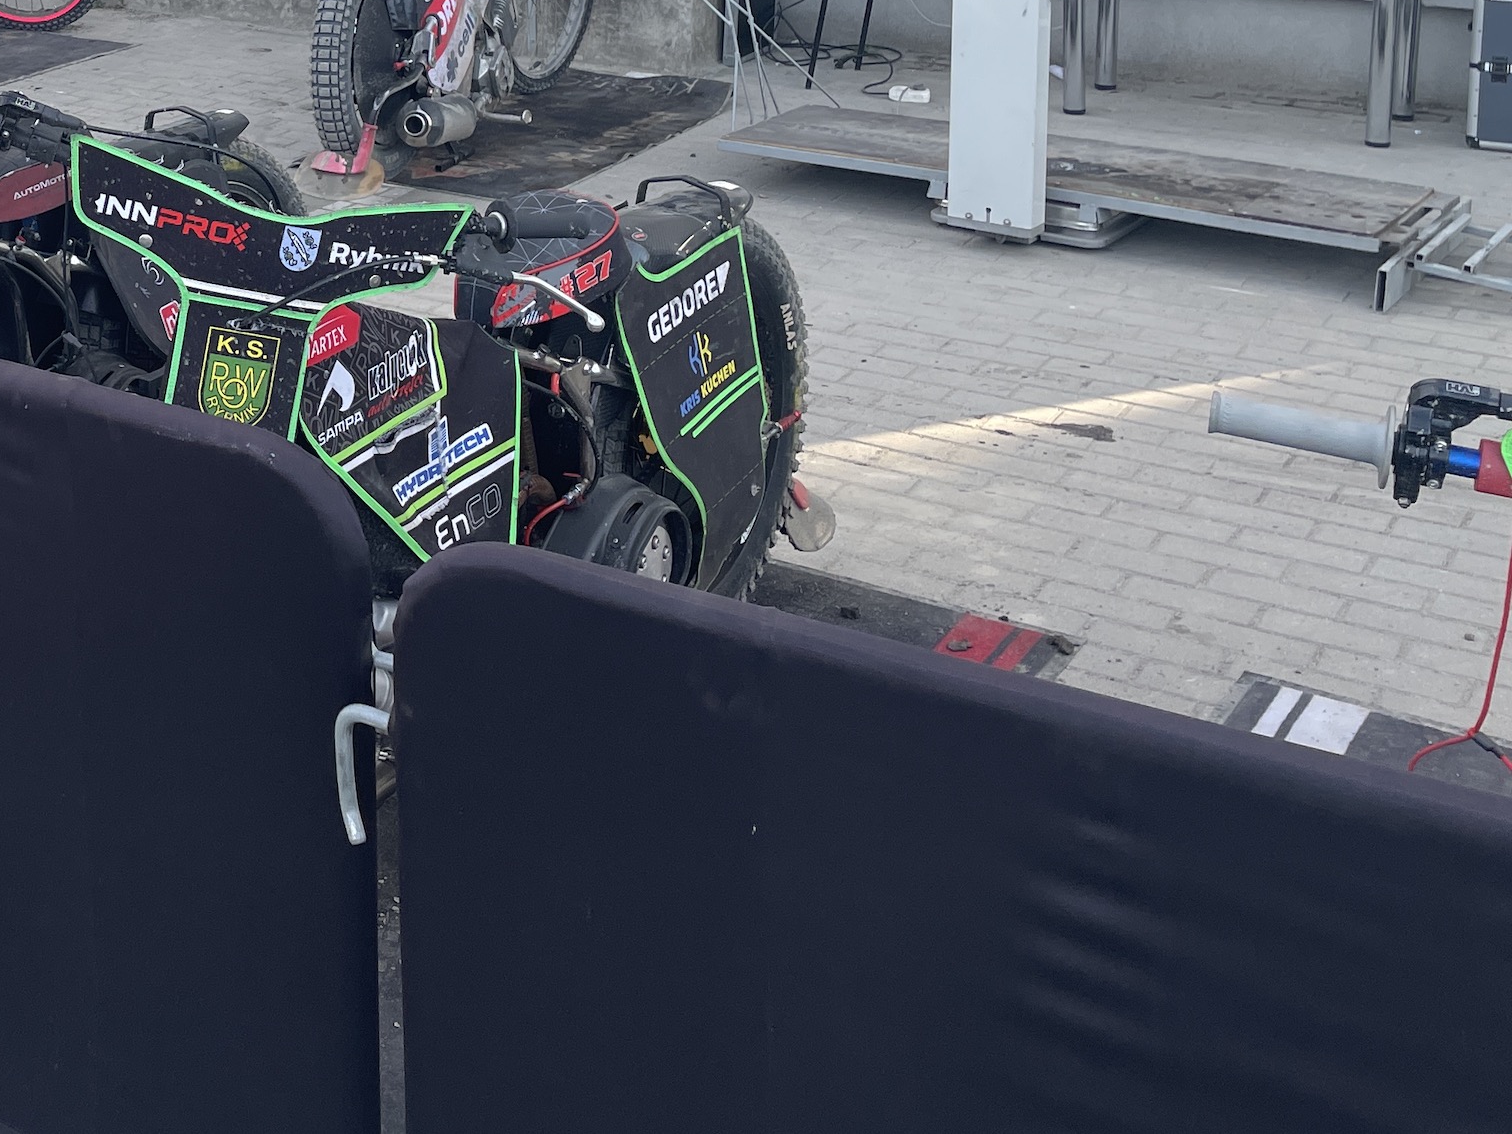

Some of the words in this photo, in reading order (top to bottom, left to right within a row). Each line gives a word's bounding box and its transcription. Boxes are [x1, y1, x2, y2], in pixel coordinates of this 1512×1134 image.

[95, 193, 235, 244] INNPRO
[647, 272, 720, 344] GEDORE
[779, 303, 797, 350] ANLAS
[679, 389, 701, 418] KRIS
[318, 412, 364, 446] SAMPA
